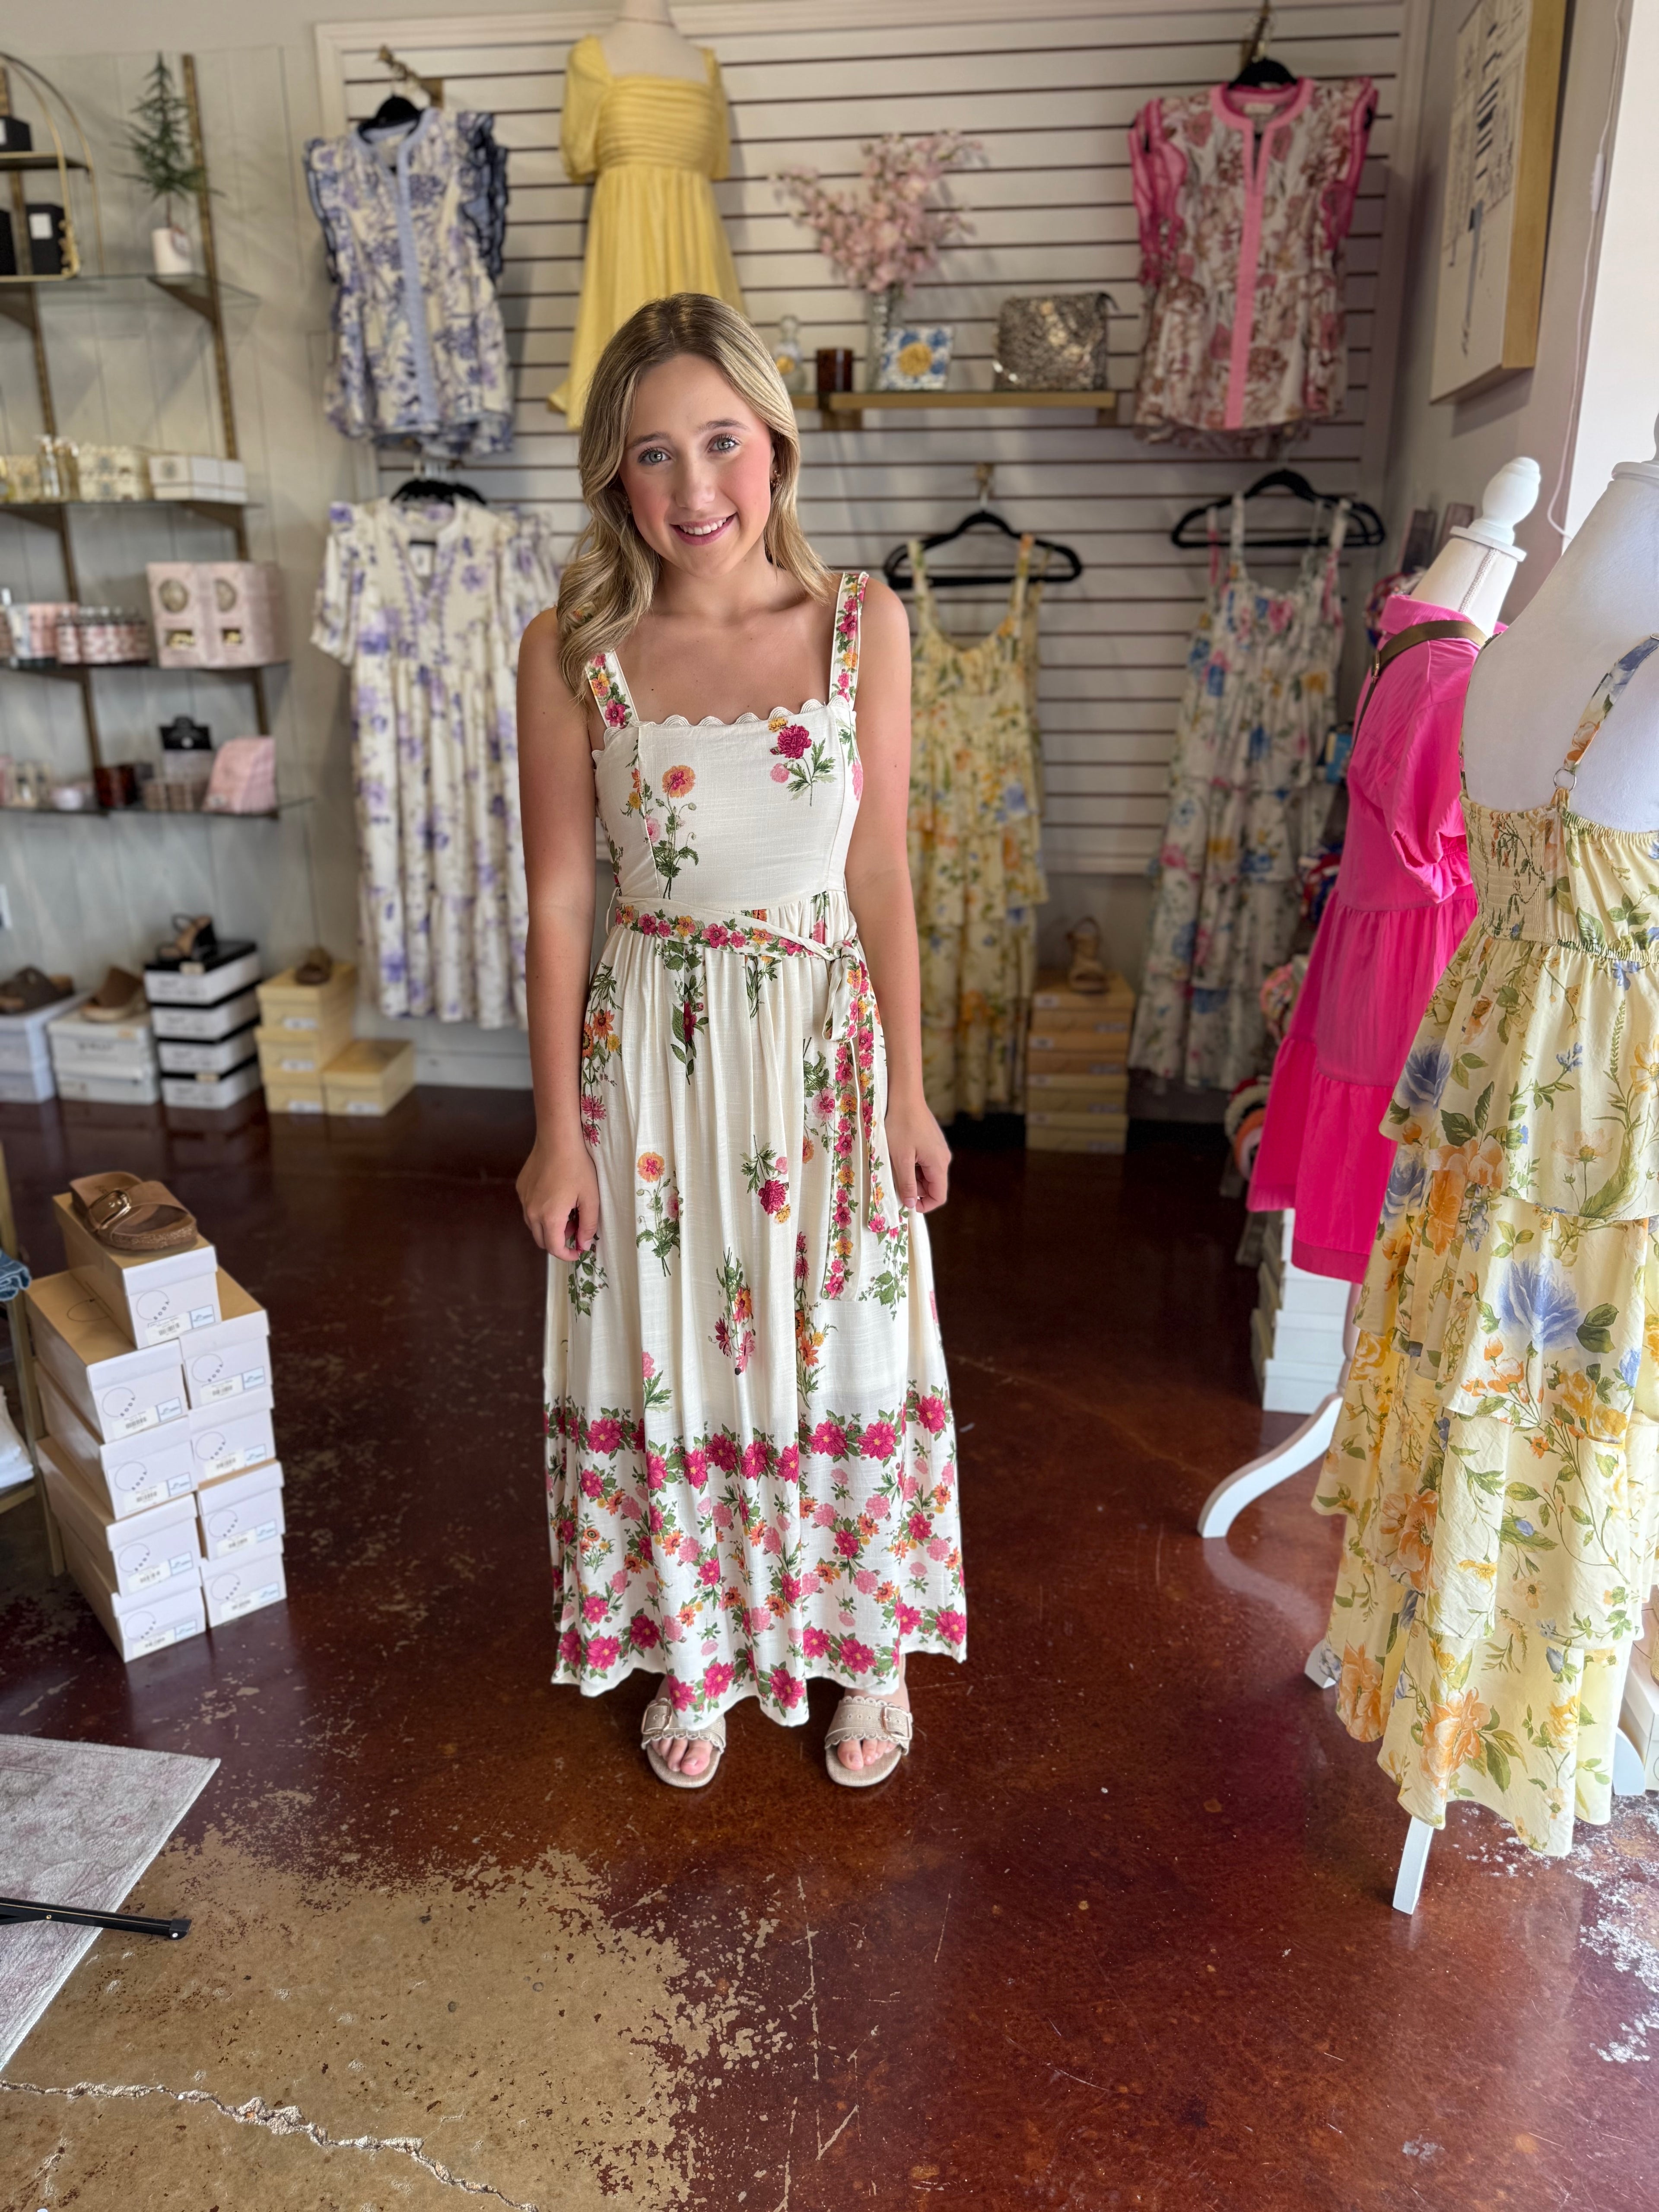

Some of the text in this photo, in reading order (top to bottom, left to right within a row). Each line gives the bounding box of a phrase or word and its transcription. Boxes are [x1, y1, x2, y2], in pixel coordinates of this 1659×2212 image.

[154, 1300, 170, 1320] SODA
[207, 1364, 223, 1382] SODA
[120, 1397, 136, 1417] SODA
[210, 1442, 226, 1459] SODA
[131, 1471, 147, 1491] SODA
